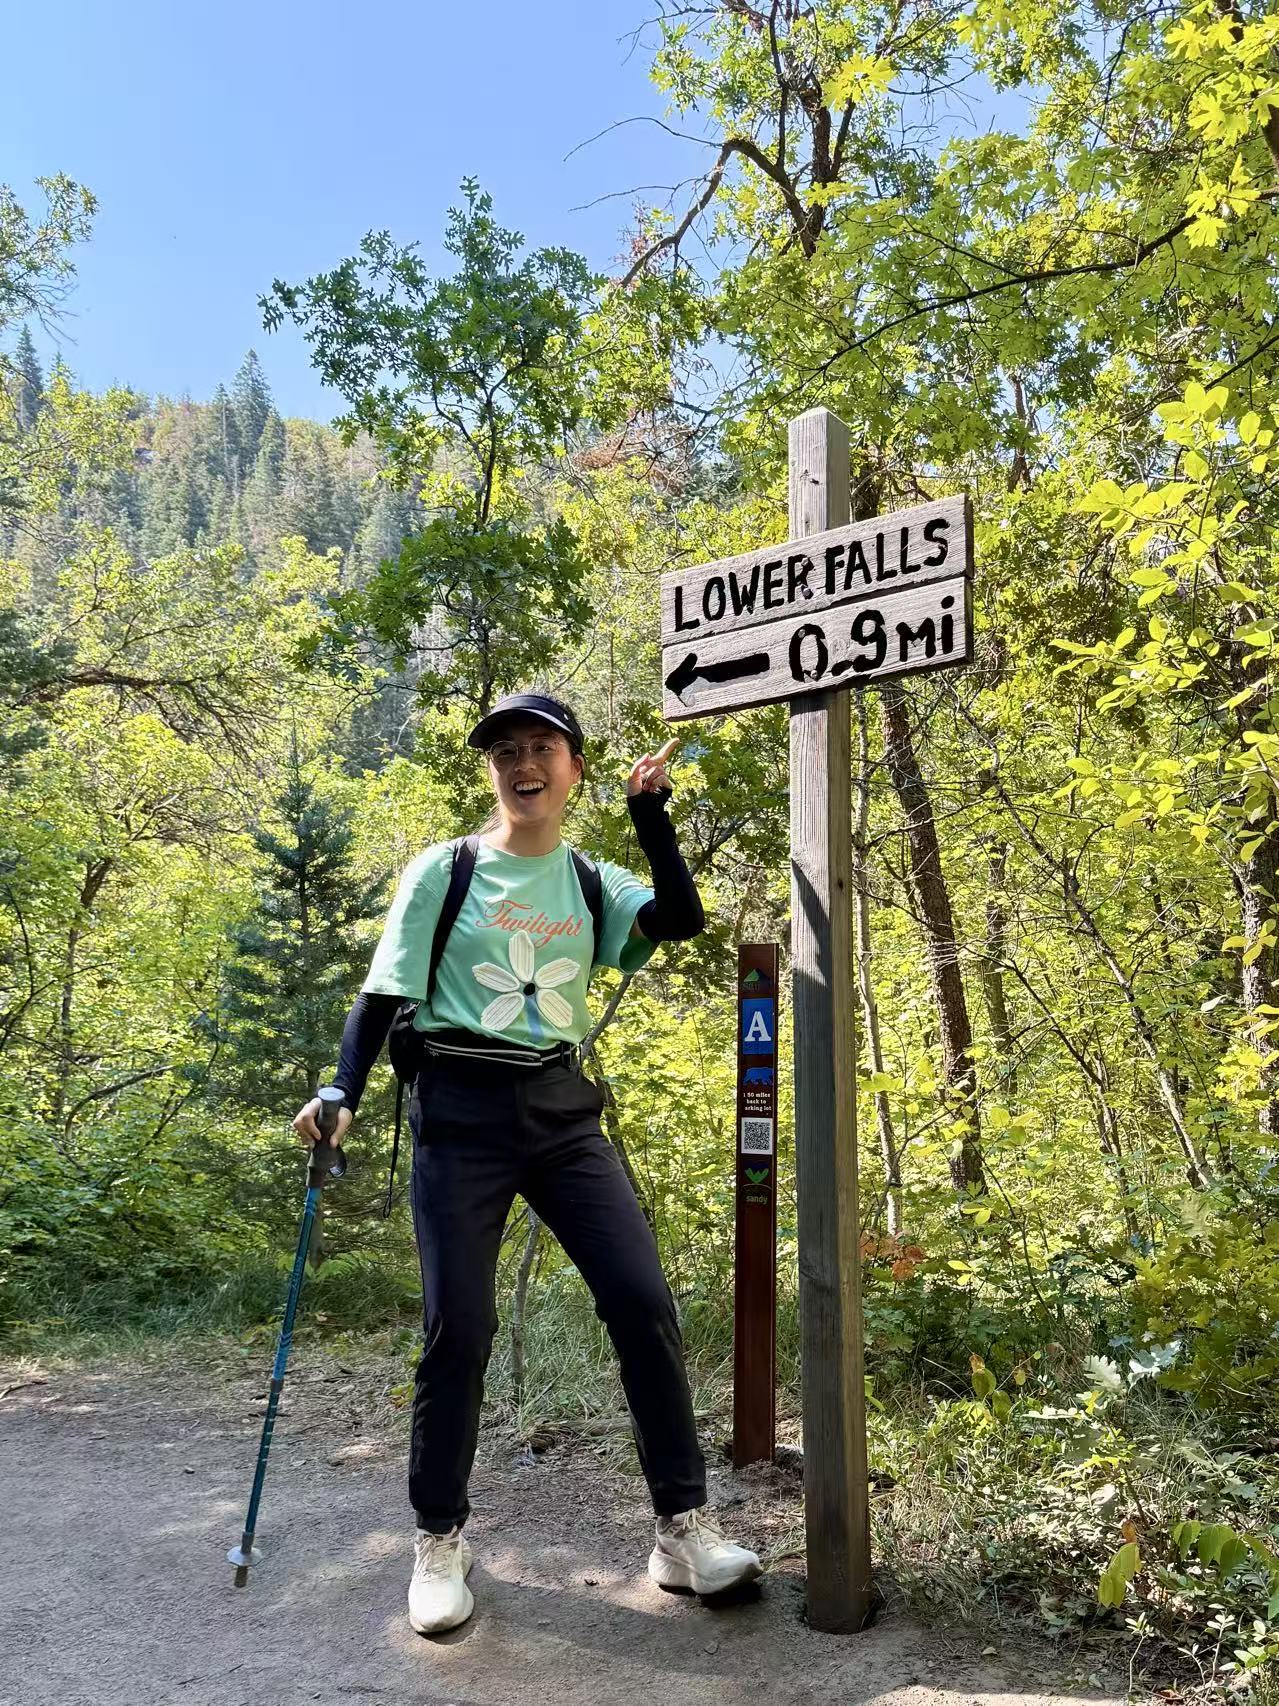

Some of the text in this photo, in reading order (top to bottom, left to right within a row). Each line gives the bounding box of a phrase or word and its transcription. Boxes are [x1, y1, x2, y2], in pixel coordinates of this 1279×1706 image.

[674, 518, 950, 632] LOWER FALLS
[788, 609, 888, 683] 0.9
[475, 899, 584, 948] Twilight
[744, 1010, 772, 1041] A
